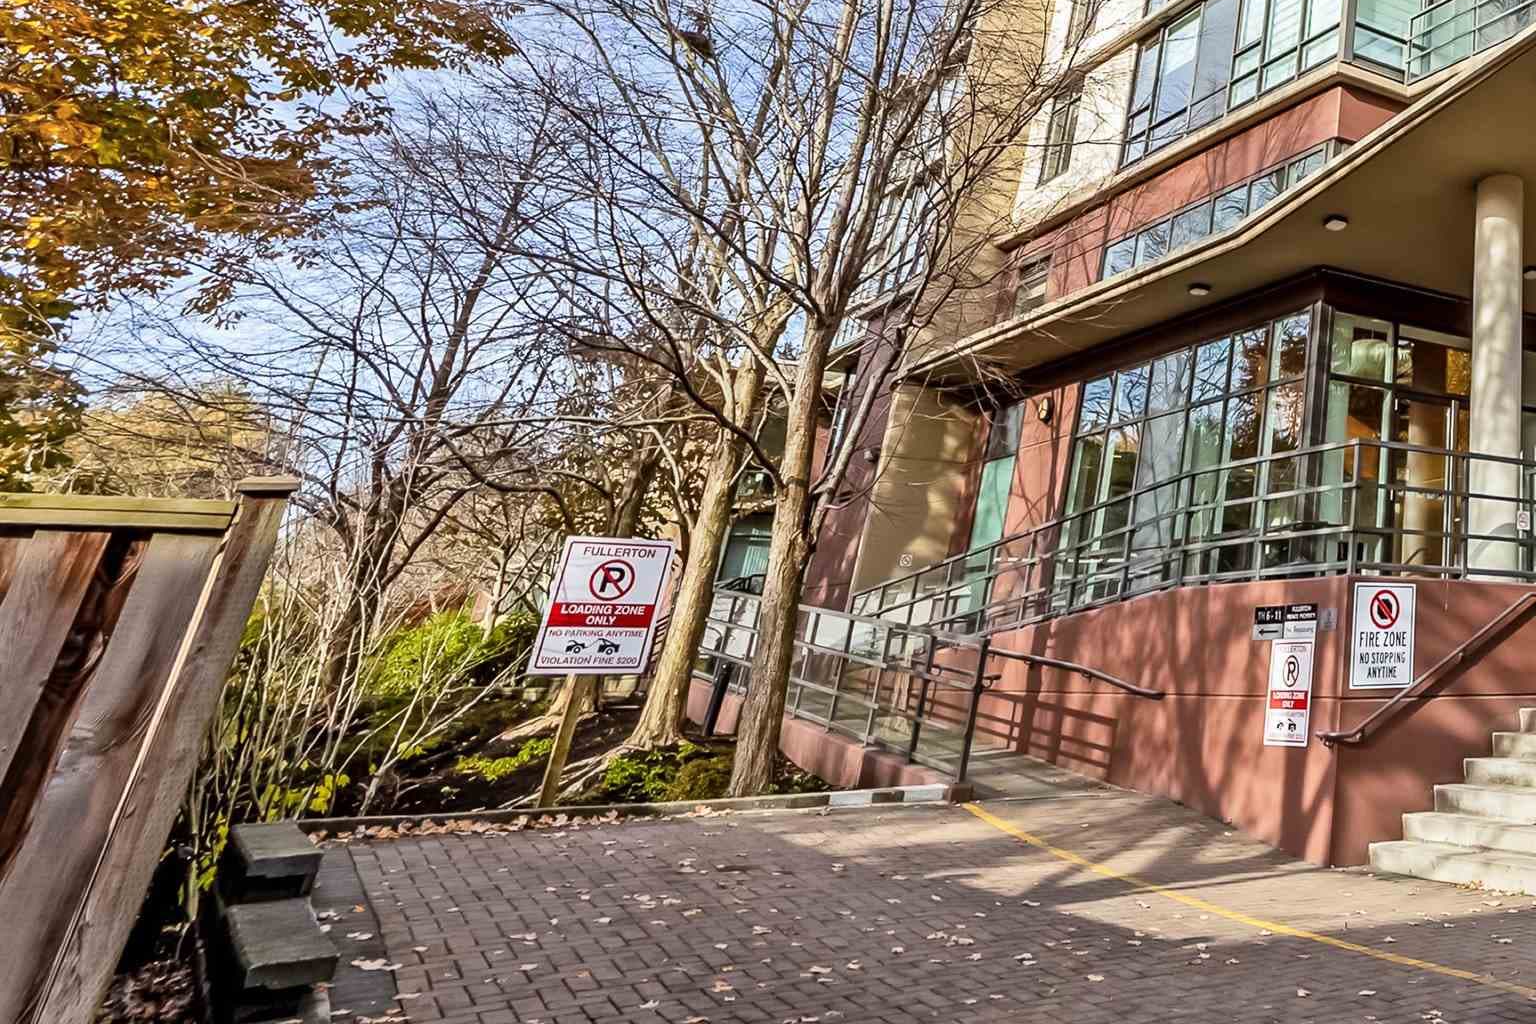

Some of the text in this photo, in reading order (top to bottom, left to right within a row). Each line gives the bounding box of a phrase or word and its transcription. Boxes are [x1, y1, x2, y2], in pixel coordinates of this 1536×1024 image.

[584, 546, 656, 558] FULLERTON
[561, 604, 646, 615] LOADING ZONE
[585, 616, 616, 625] ONLY
[549, 629, 643, 638] NO PARKING ANYTIME
[1359, 631, 1407, 647] FIRE ZONE
[541, 656, 637, 664] VIOLATION FINE $200
[1359, 651, 1406, 664] NO STOPPING
[1367, 666, 1397, 678] ANYTIME
